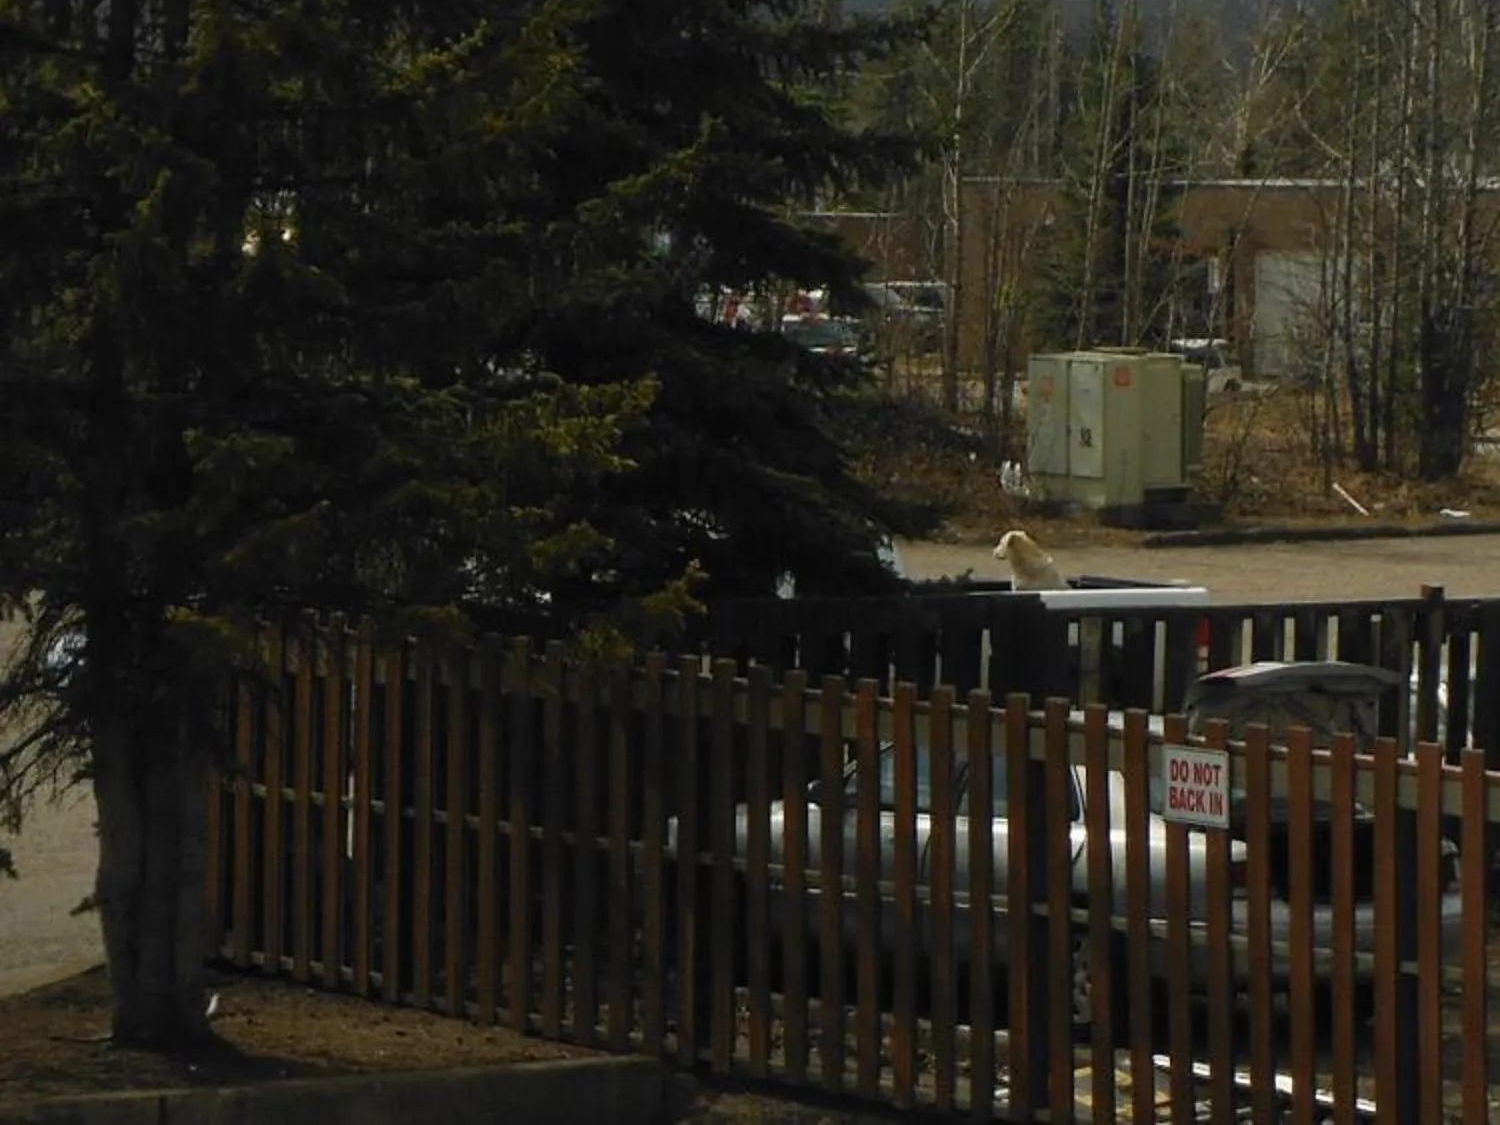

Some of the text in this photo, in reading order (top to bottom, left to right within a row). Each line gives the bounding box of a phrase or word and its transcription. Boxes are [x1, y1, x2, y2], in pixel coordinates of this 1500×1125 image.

[1170, 758, 1221, 788] DO NOT
[1169, 786, 1223, 816] BACK IN
